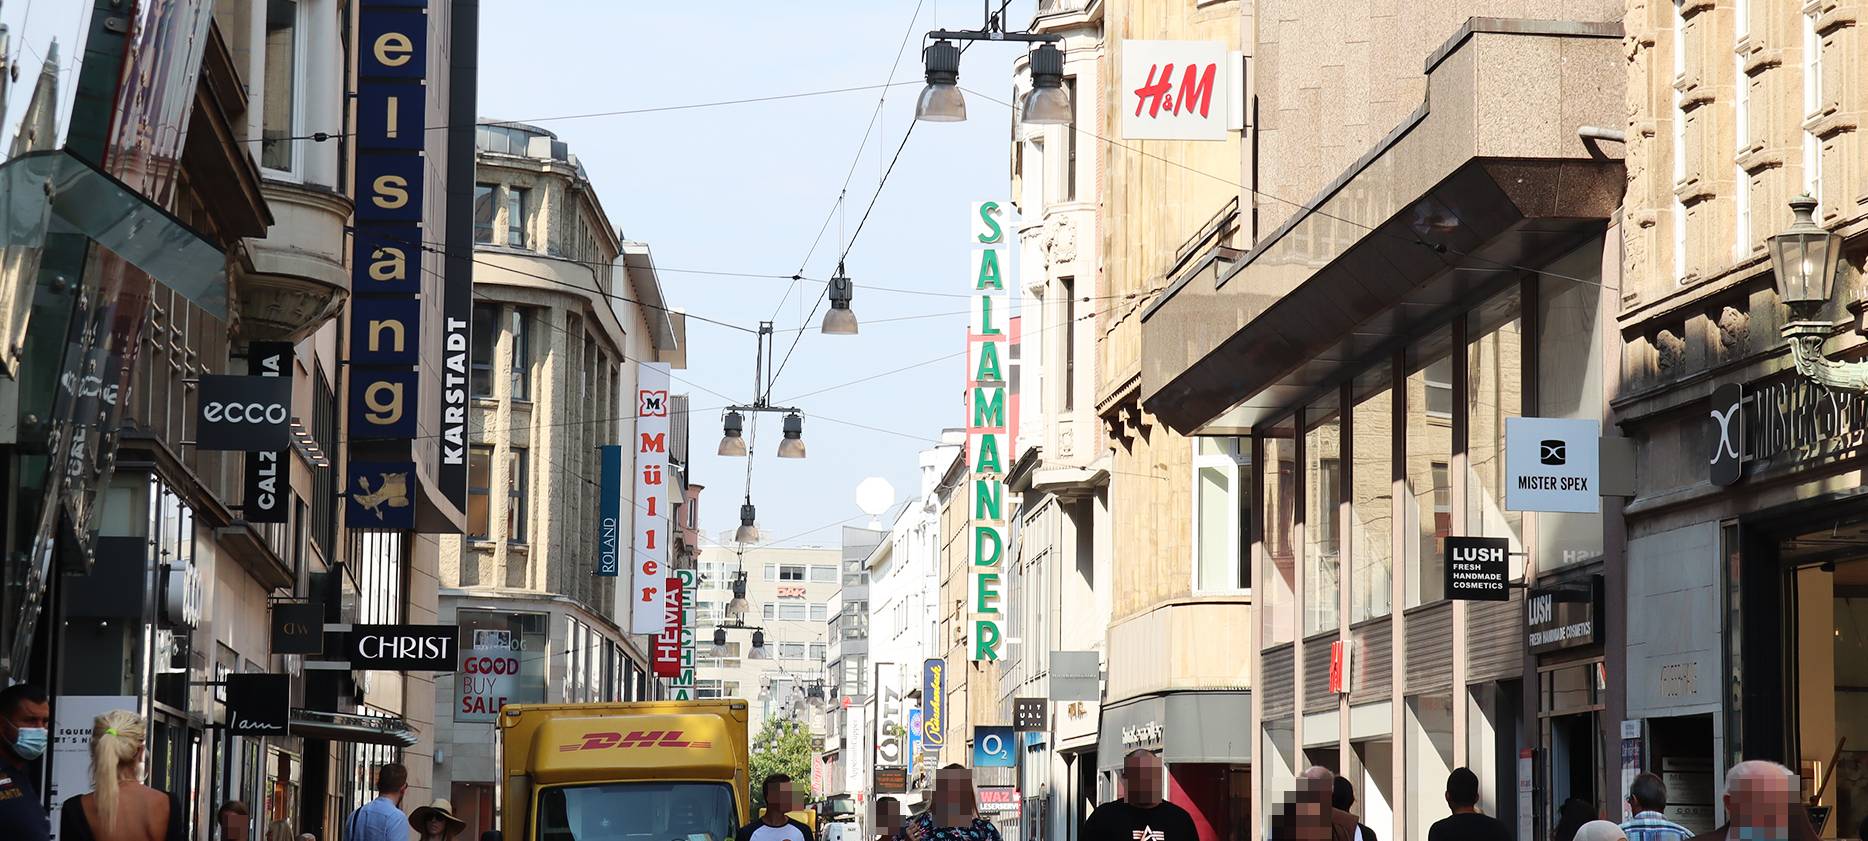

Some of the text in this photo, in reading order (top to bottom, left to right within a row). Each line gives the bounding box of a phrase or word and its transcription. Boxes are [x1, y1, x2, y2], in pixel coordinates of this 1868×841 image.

[1134, 63, 1217, 119] H&M
[443, 317, 467, 466] KARSTADT
[203, 401, 287, 425] ecco
[975, 201, 1006, 661] SALAMANDER
[1518, 476, 1588, 491] MISTER SPEX
[639, 432, 666, 602] Müller
[602, 517, 617, 573] ROLAND
[1453, 547, 1504, 562] LUSH
[1453, 563, 1481, 571] FRESH
[1453, 572, 1502, 580] HANDMADE
[1453, 581, 1503, 590] COSMETICS
[1528, 593, 1552, 626] LUSH
[657, 588, 679, 662] HEMA
[358, 635, 452, 660] CHRIST
[463, 656, 519, 675] GOOD
[463, 676, 497, 694] BUY
[579, 731, 691, 750] DHL
[979, 791, 1010, 802] WAZ
